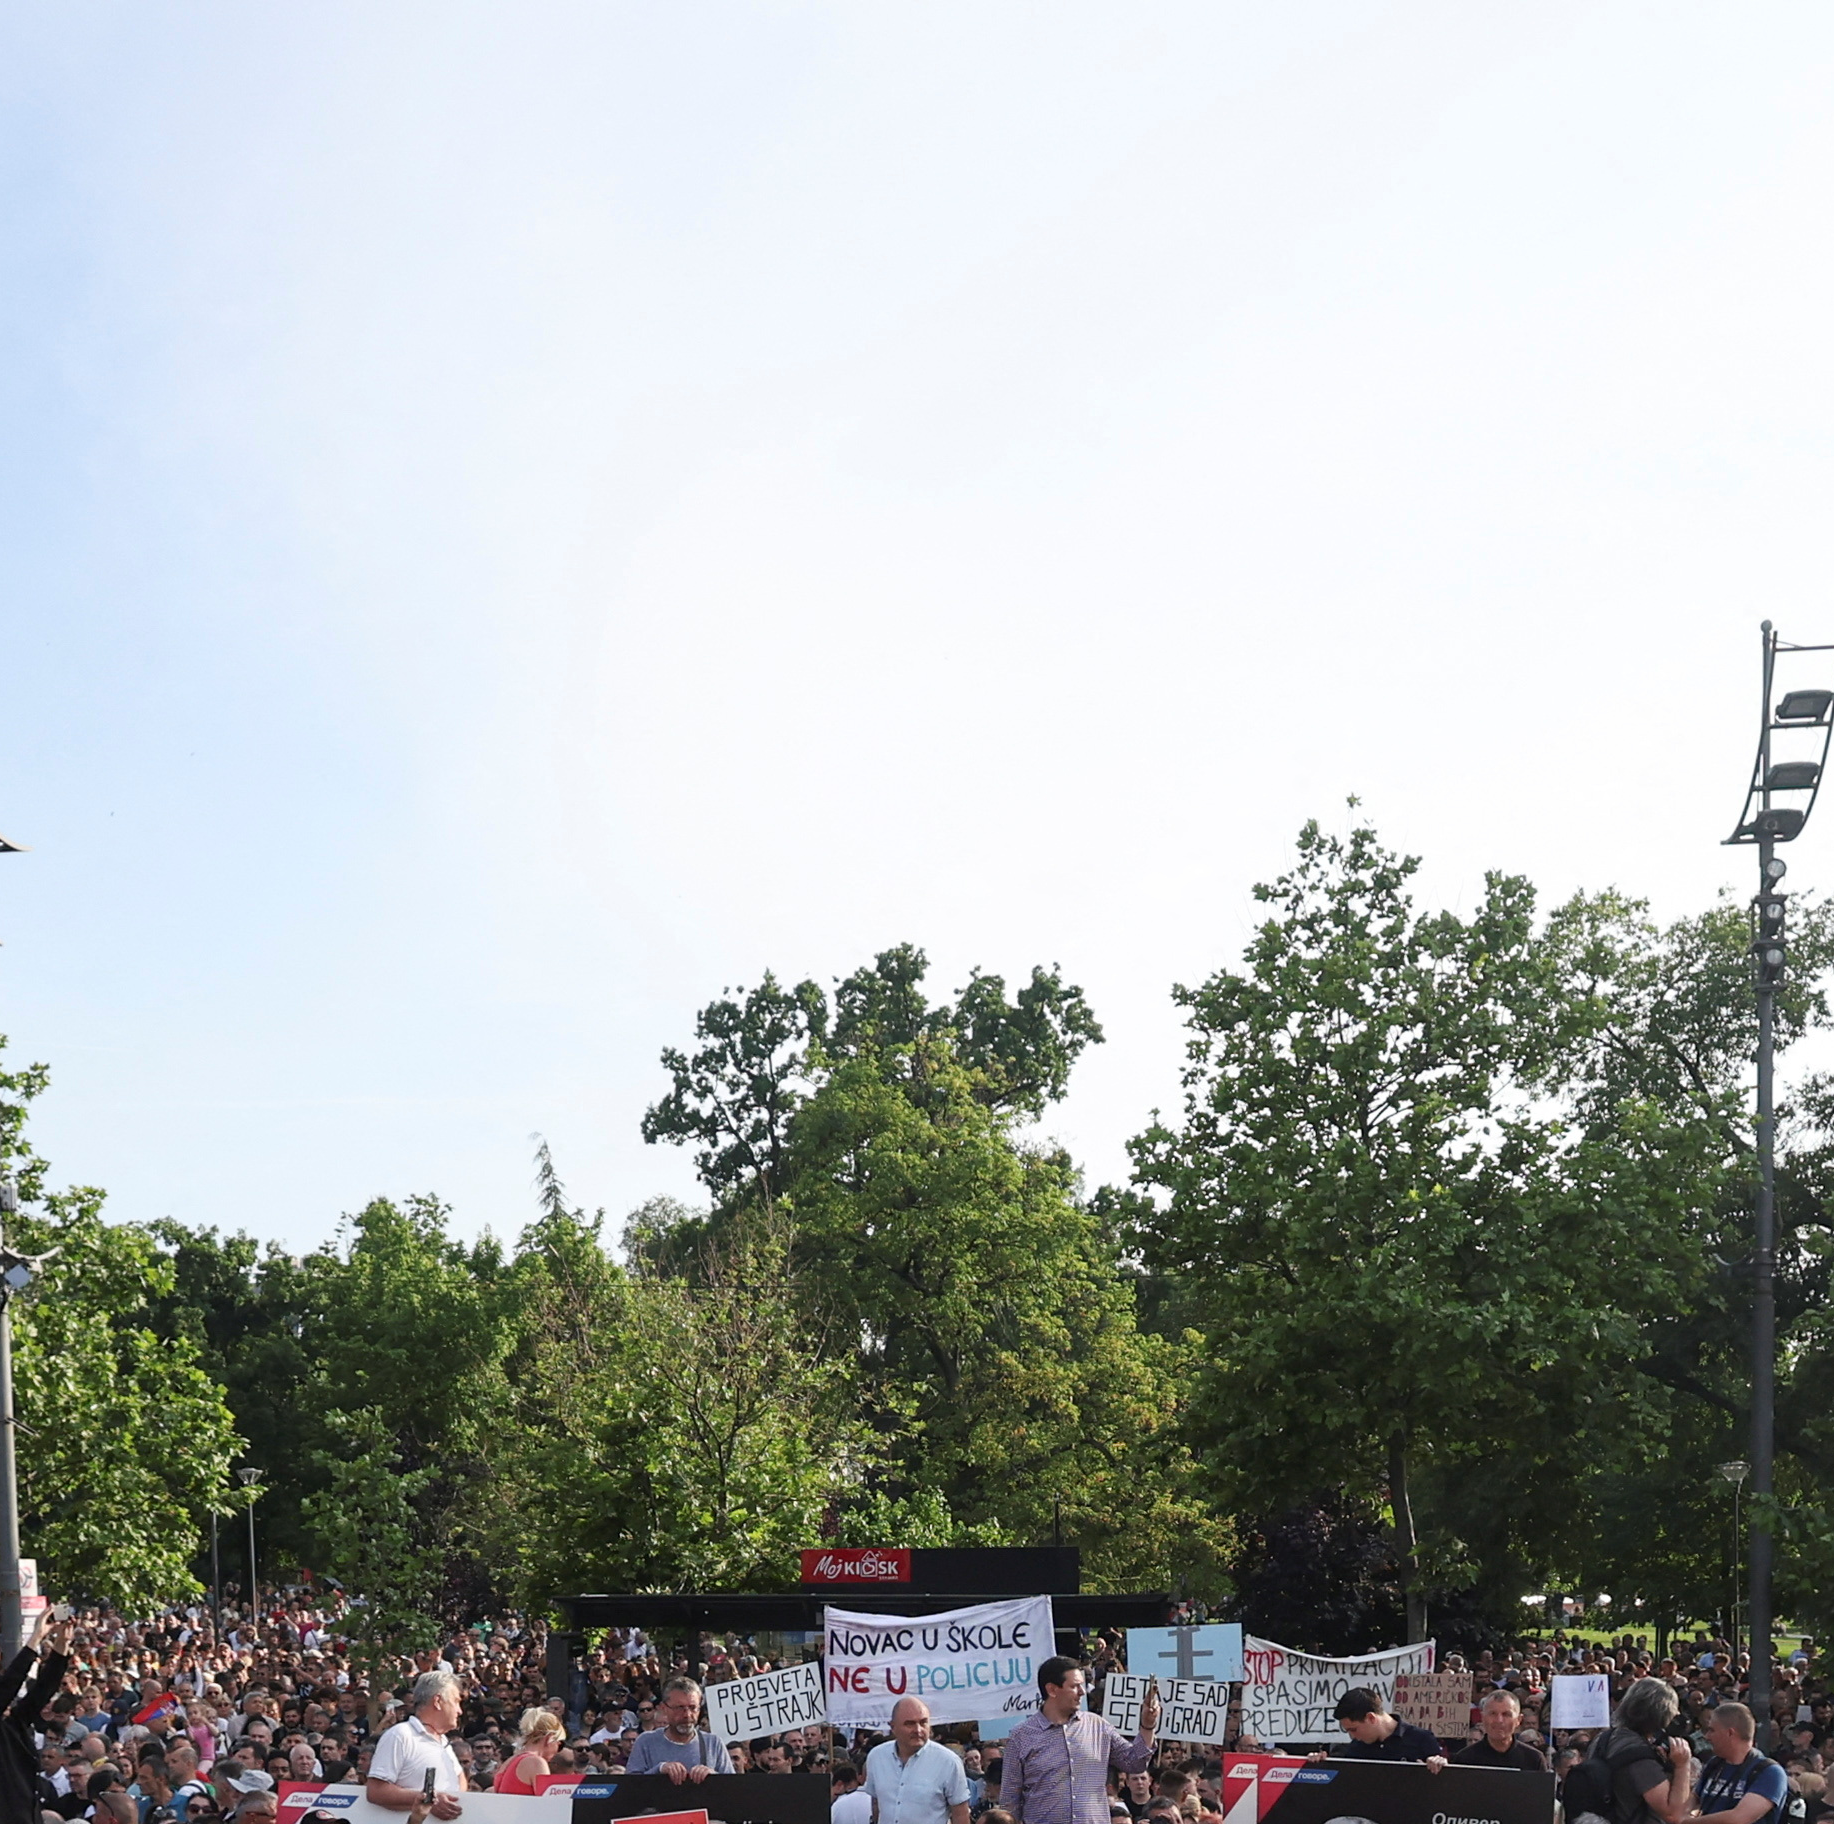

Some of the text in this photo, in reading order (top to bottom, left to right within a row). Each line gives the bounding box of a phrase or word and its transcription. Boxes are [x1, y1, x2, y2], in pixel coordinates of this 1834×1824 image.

[813, 1555, 843, 1579] Moj
[829, 1621, 1031, 1657] NOVAC U ŠKOLE
[829, 1656, 1032, 1695] NE U POLICIJU
[1242, 1650, 1284, 1686] STOP
[718, 1671, 816, 1707] PROSVETA
[1111, 1677, 1228, 1708] USTJE SAD
[1252, 1678, 1350, 1707] SPASIMO
[725, 1689, 823, 1736] U ŠTRAJK
[1171, 1706, 1217, 1737] GRAD
[1239, 1707, 1349, 1738] PREDUZE
[548, 1786, 609, 1797] Дела говоре.
[1270, 1770, 1330, 1783] Дела говоре.
[290, 1793, 351, 1806] Дела говоре.
